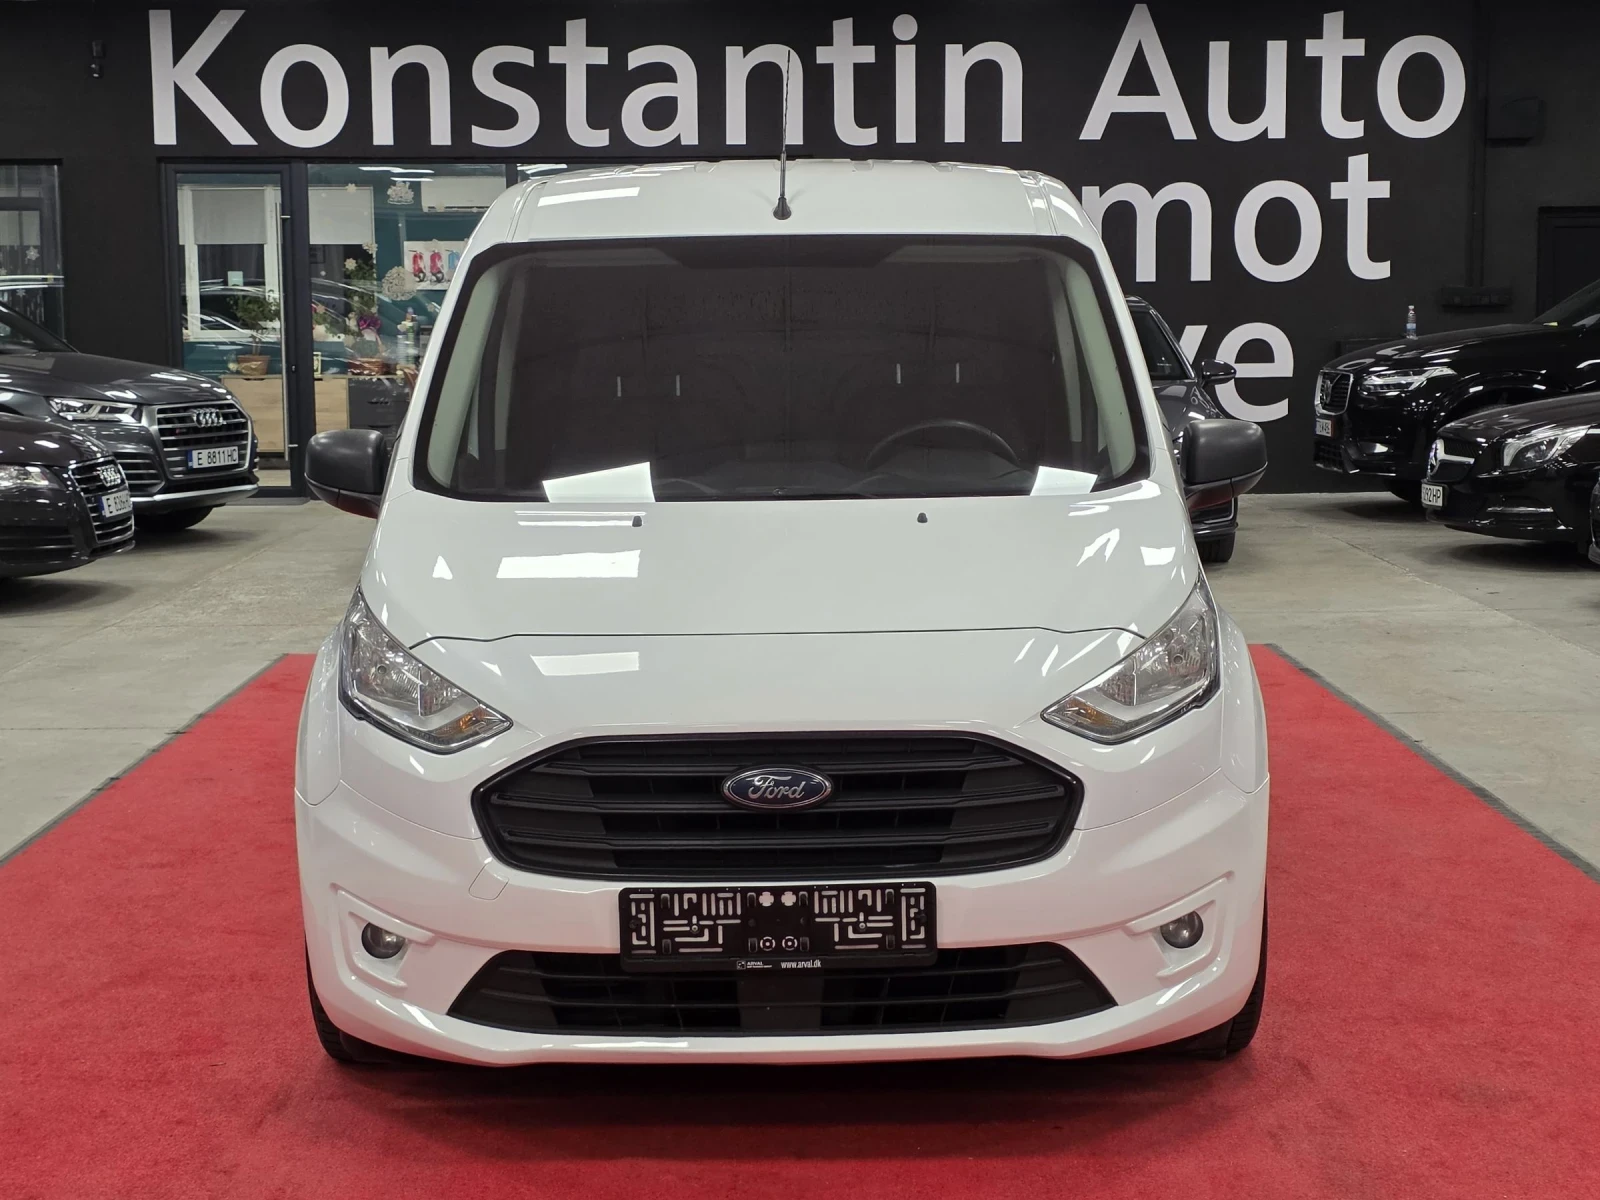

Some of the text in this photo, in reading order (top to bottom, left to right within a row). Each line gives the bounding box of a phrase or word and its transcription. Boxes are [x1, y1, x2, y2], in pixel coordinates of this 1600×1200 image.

[149, 3, 1466, 149] Konstantin Auto
[745, 774, 806, 799] Ford
[780, 959, 822, 969] www.arval.dk
